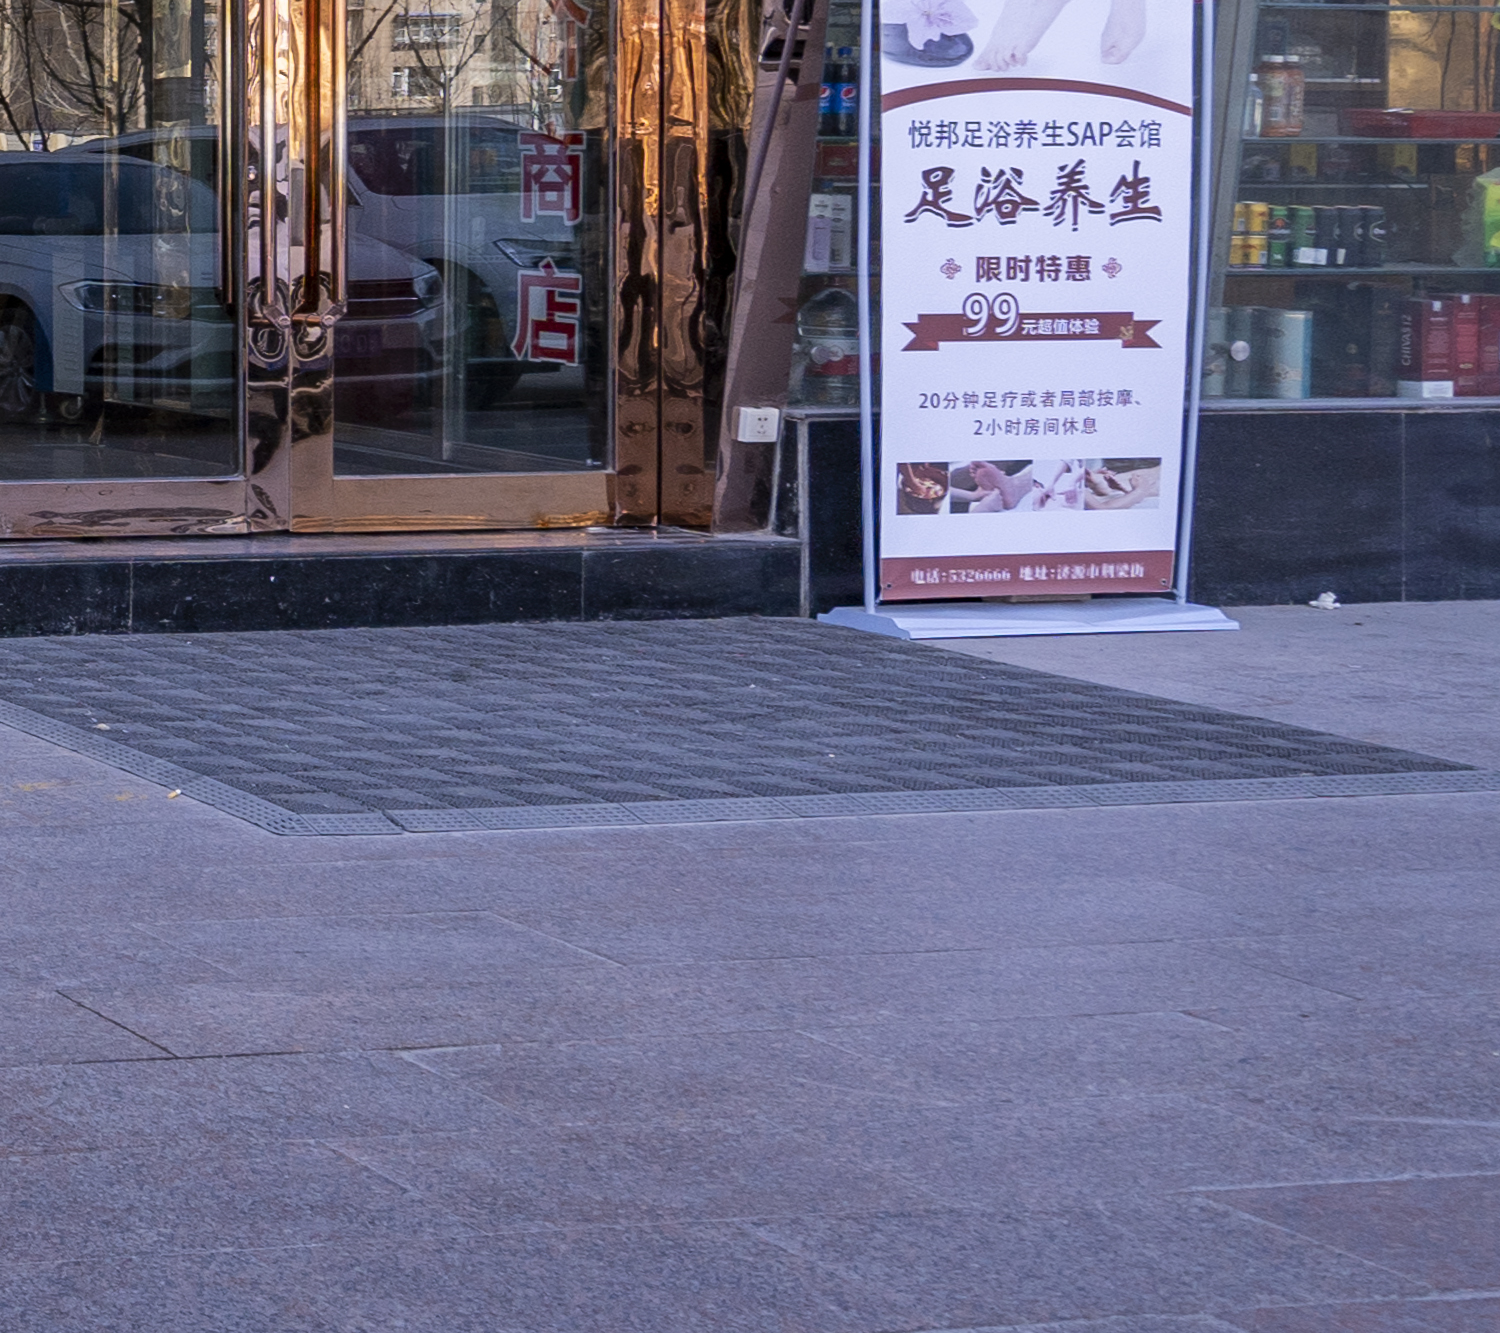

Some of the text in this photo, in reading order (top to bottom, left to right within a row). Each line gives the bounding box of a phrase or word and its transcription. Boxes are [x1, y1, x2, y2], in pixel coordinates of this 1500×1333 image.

[908, 119, 1163, 150] 悦邦足浴养生SAP会馆
[903, 158, 1164, 232] 足浴养生
[975, 254, 1093, 283] 限时特惠
[973, 416, 1099, 437] 2小时房间休息
